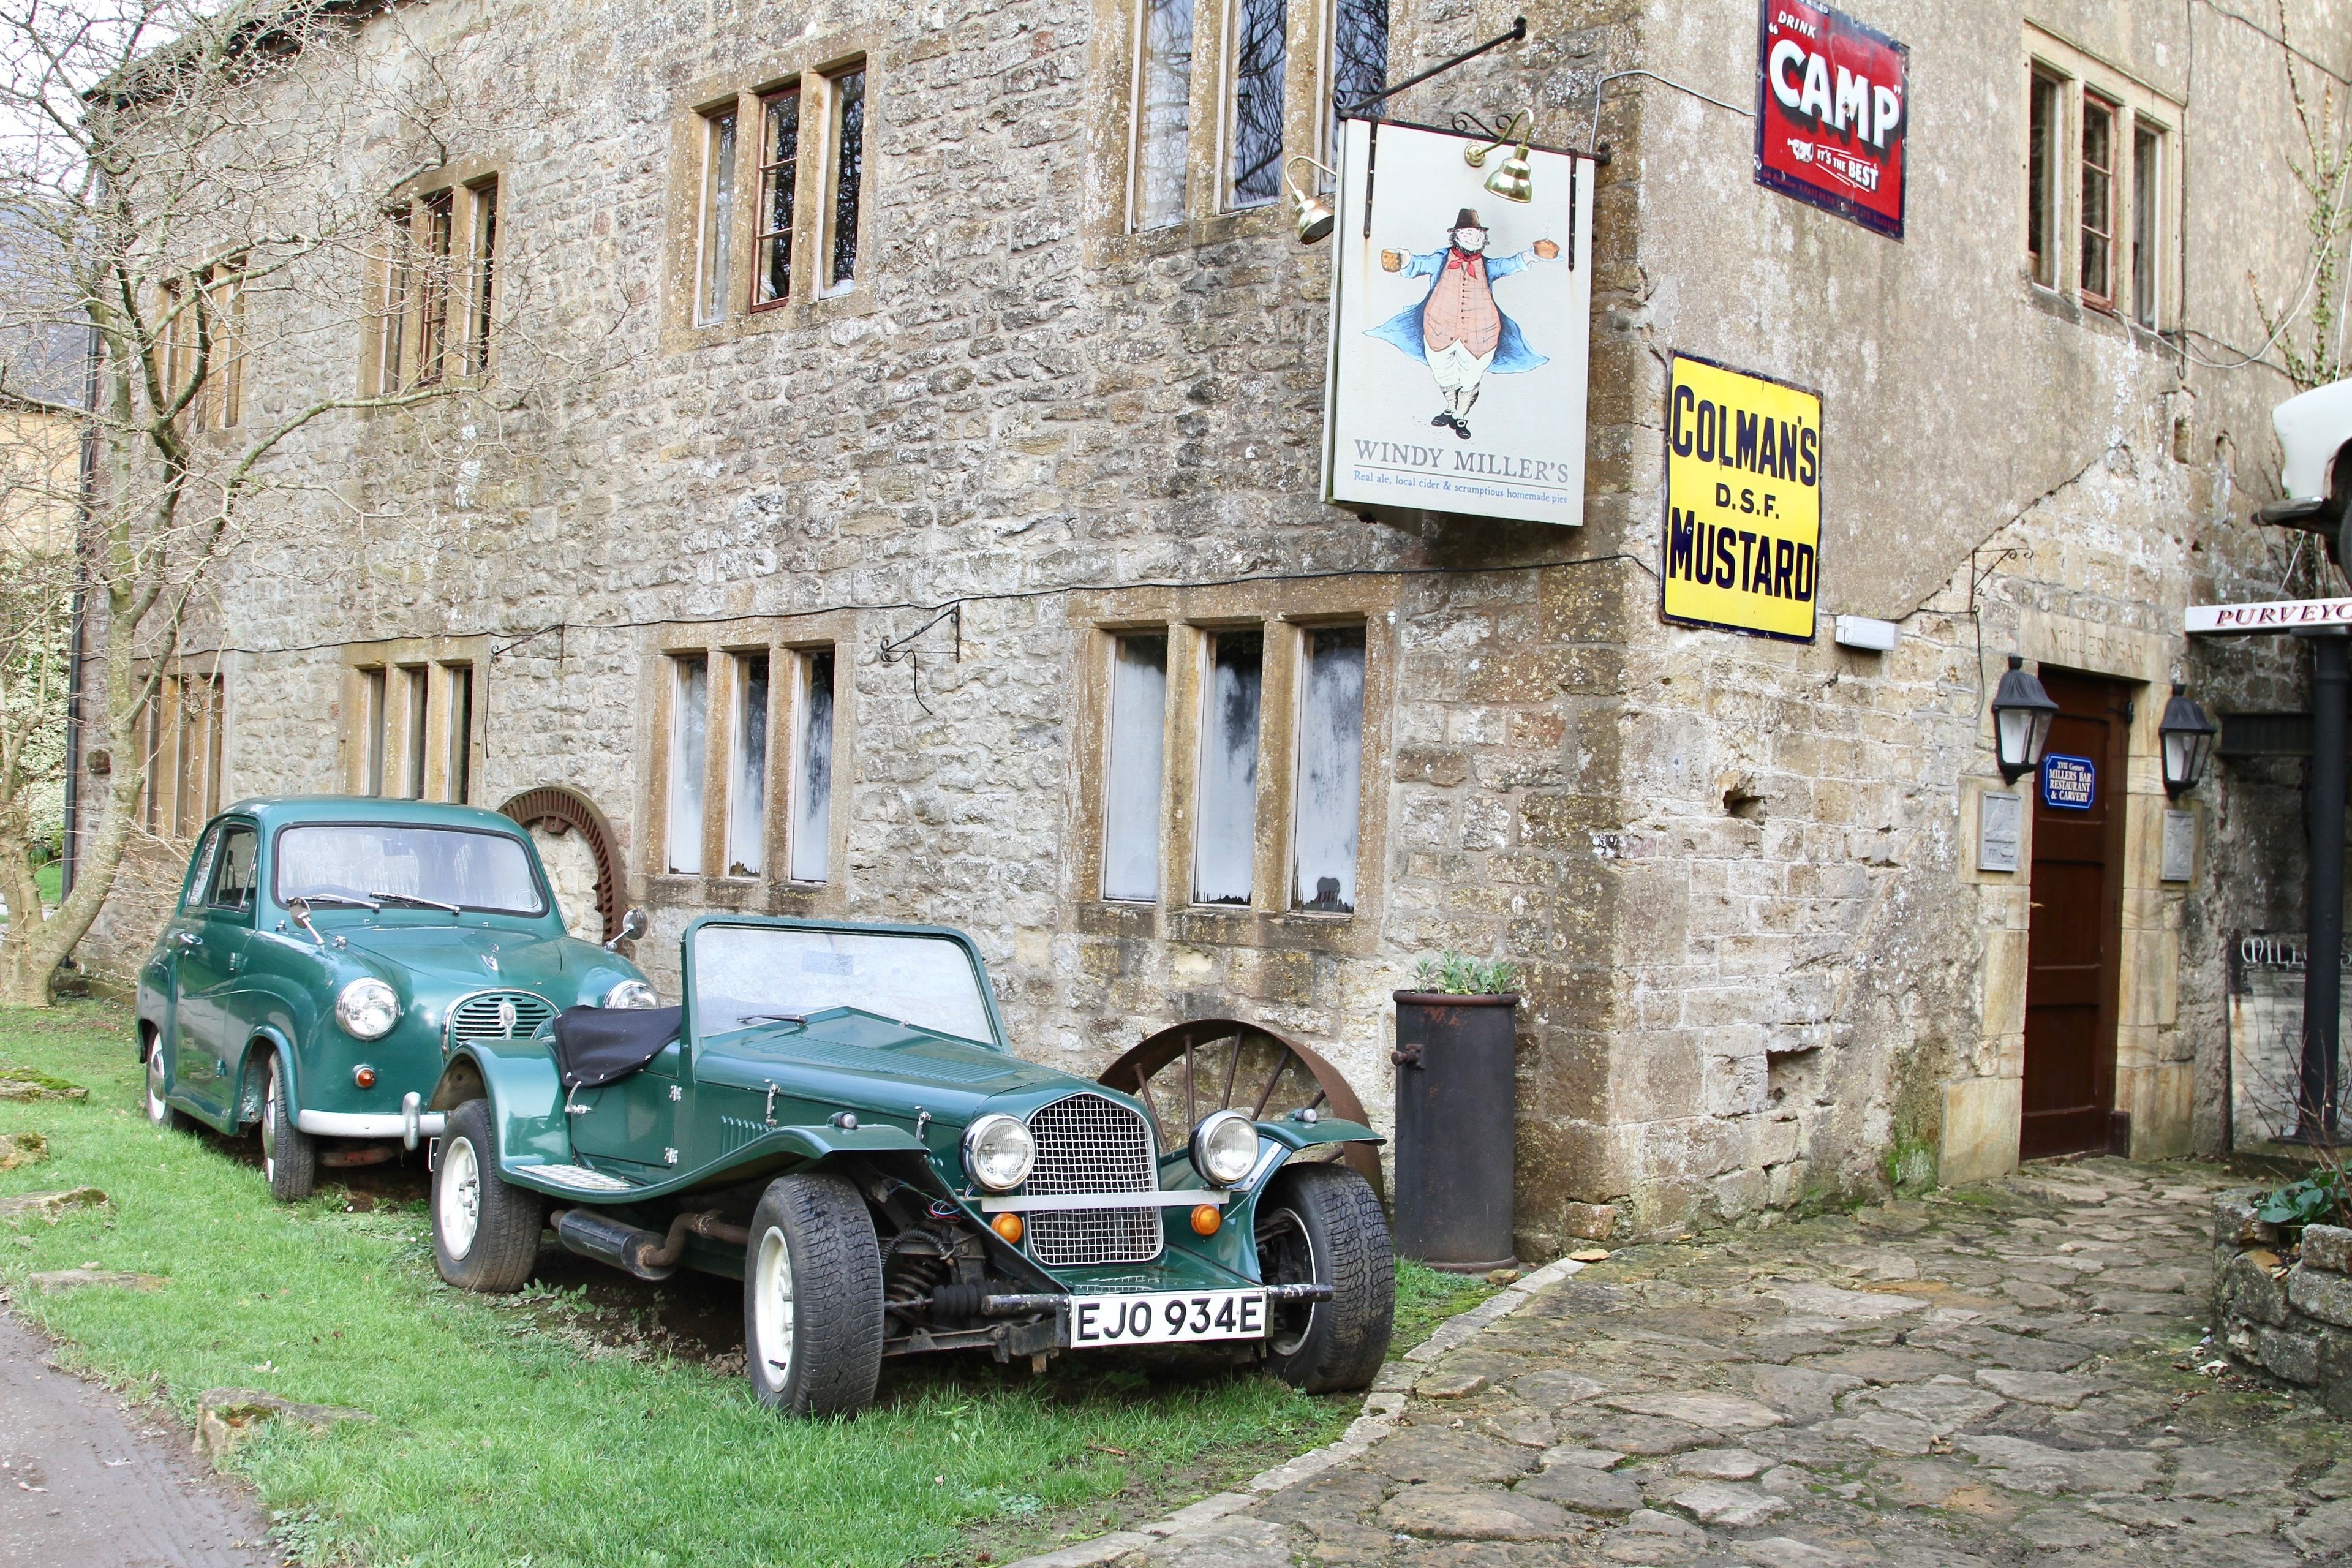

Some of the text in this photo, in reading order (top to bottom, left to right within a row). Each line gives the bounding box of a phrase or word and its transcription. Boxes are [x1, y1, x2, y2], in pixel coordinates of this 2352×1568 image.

[1777, 10, 1817, 39] DRINK
[1817, 149, 1879, 190] IT'S THE BEST
[1672, 385, 1817, 486] COLMAN'S
[1354, 439, 1569, 484] WINDY MILLER'S
[1354, 470, 1568, 505] Real ale, local cider & scrumptious homemade pies
[1716, 482, 1779, 519] D.S.F.
[1669, 507, 1815, 603] MUSTARD
[2049, 769, 2092, 783] MILLERS BAR
[2057, 761, 2068, 770] XVII
[2049, 779, 2091, 793] RESTAURANT
[2051, 790, 2089, 802] & CARVERY
[1077, 1295, 1262, 1341] EJO 934E
